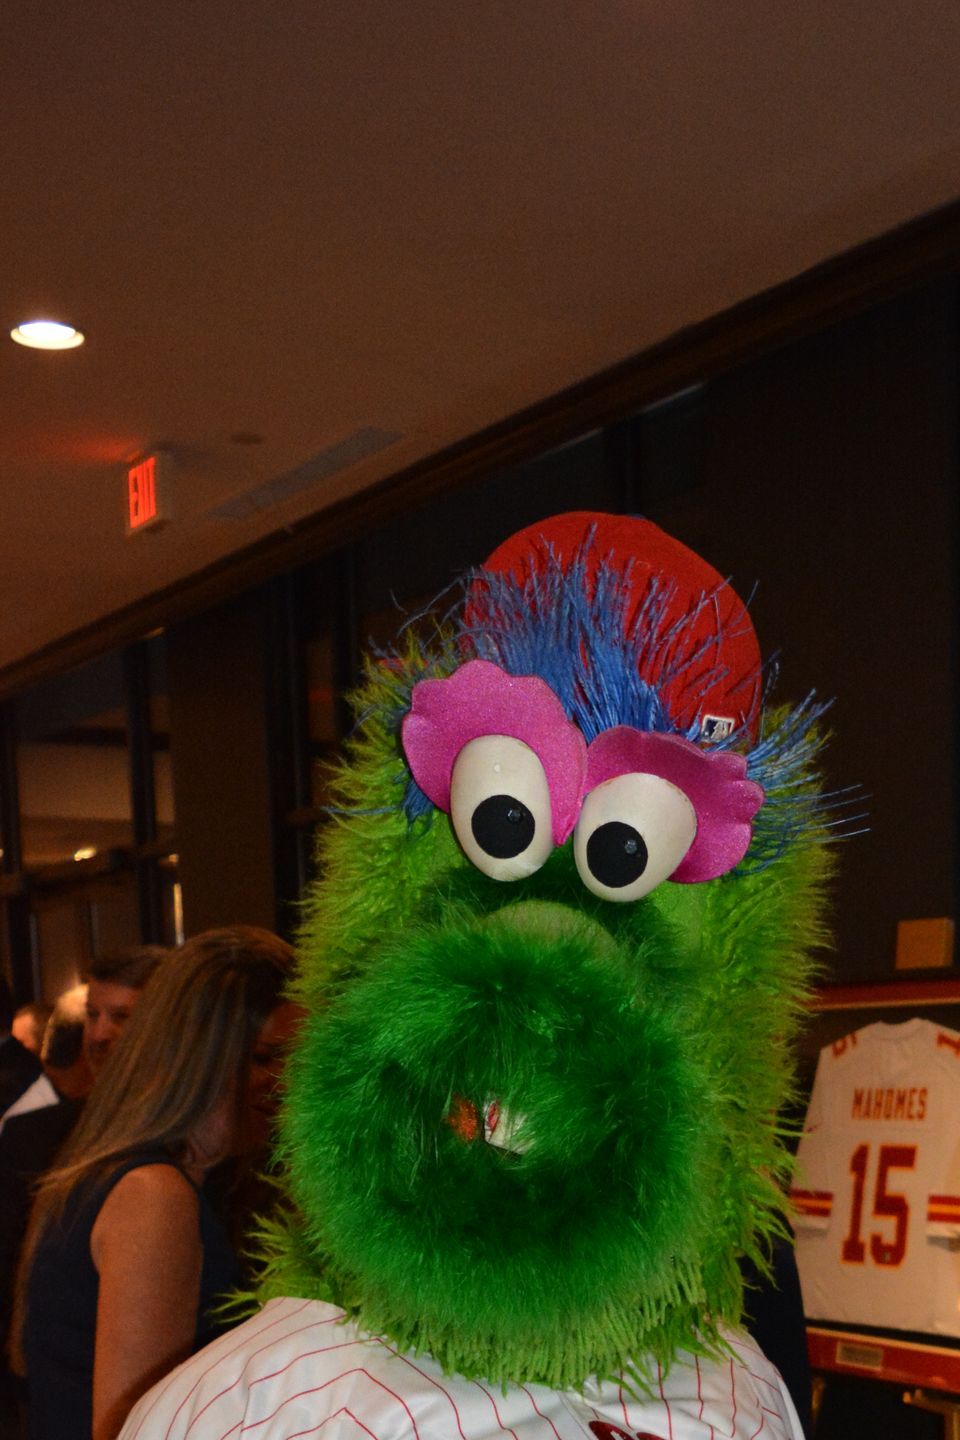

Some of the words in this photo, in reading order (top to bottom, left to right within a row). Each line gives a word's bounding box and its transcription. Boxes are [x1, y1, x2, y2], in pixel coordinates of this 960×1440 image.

[128, 456, 157, 529] EXIT
[851, 1087, 928, 1121] MAHOMES
[841, 1142, 918, 1267] 15
